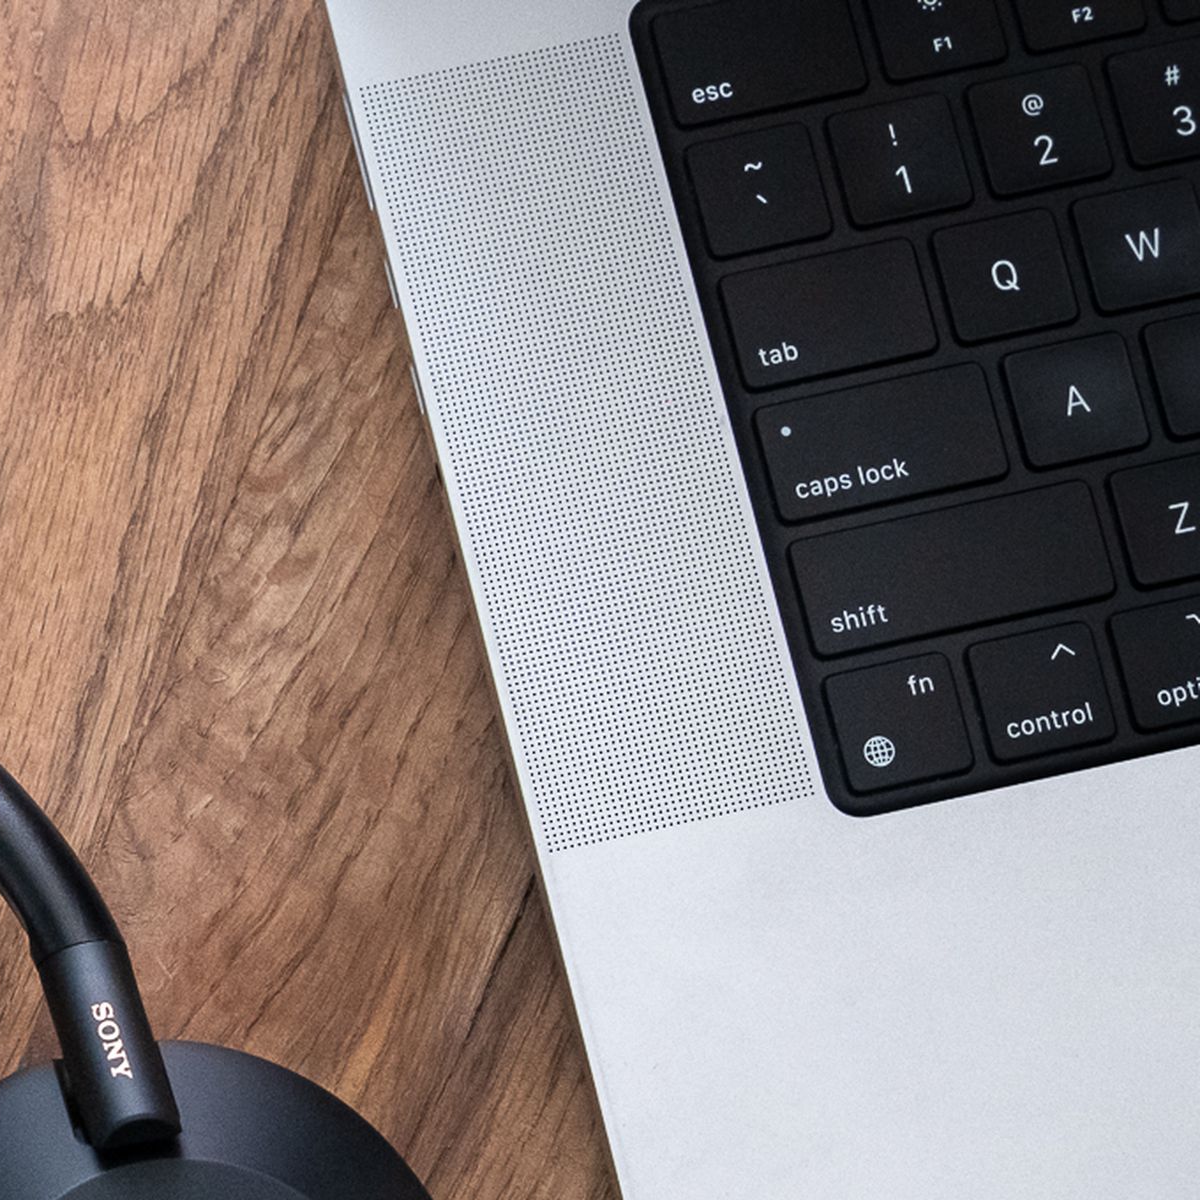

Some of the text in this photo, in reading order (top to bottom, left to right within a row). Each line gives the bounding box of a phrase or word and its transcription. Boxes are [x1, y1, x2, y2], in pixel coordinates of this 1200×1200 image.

[1071, 6, 1094, 23] F2
[933, 36, 953, 52] F1
[1165, 64, 1180, 86] #
[691, 82, 733, 104] esc
[1021, 93, 1044, 116] @
[888, 123, 898, 147] !
[1172, 105, 1197, 136] 3
[1033, 134, 1059, 166] 2
[895, 165, 912, 194] 1
[1124, 227, 1160, 262] W
[991, 259, 1020, 291] Q
[758, 341, 799, 366] tab
[1067, 385, 1091, 417] A
[795, 458, 909, 499] caps lock
[1168, 501, 1196, 535] Z
[830, 604, 889, 633] shift
[907, 674, 935, 696] fn
[1006, 701, 1093, 739] control
[91, 1001, 133, 1079] SONY
